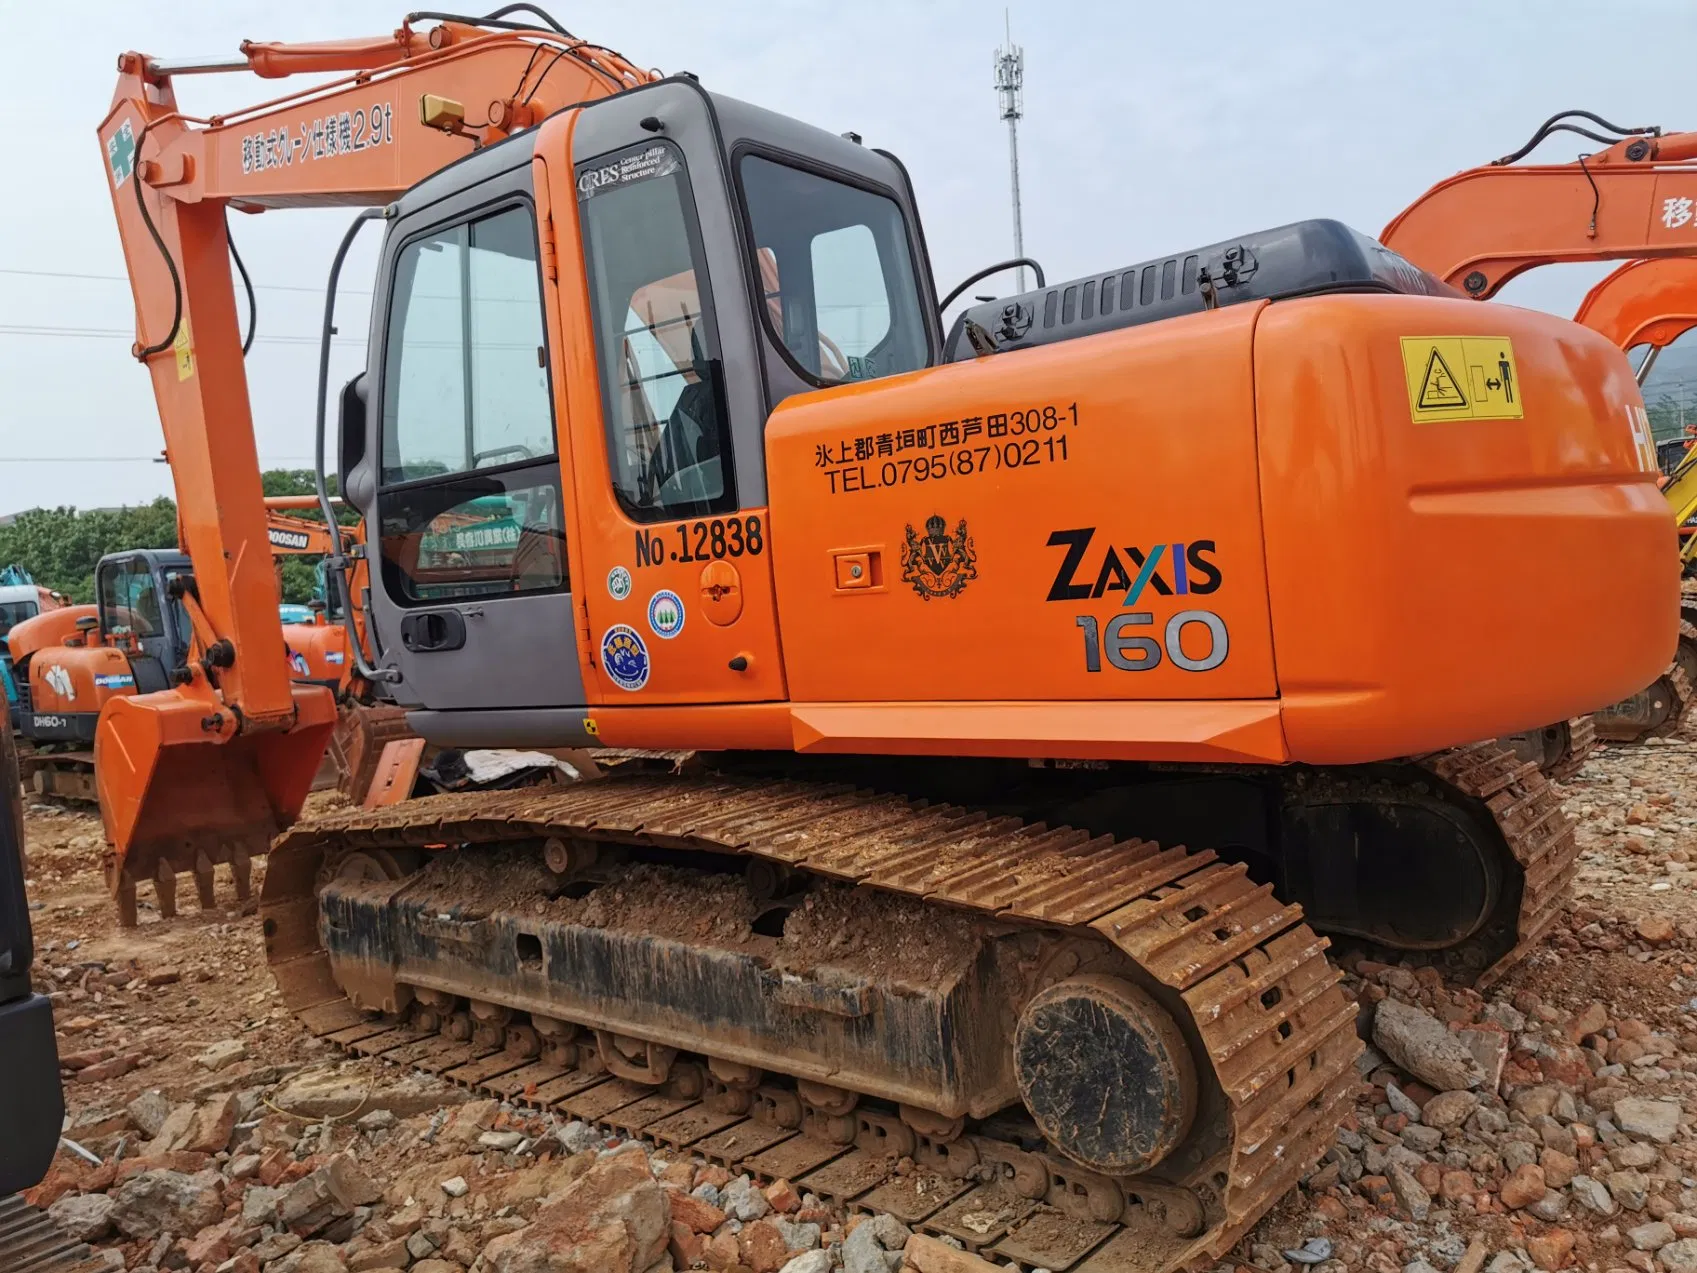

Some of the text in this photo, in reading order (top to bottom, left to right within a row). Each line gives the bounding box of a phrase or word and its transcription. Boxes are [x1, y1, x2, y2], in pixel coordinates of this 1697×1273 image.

[578, 163, 620, 193] CRES
[620, 156, 660, 175] Reinforced
[621, 166, 656, 182] Structure
[1662, 196, 1697, 228] 移
[824, 434, 1067, 494] TEL.0795(87)0211
[1045, 527, 1223, 606] ZAXIS
[1076, 610, 1230, 673] 160
